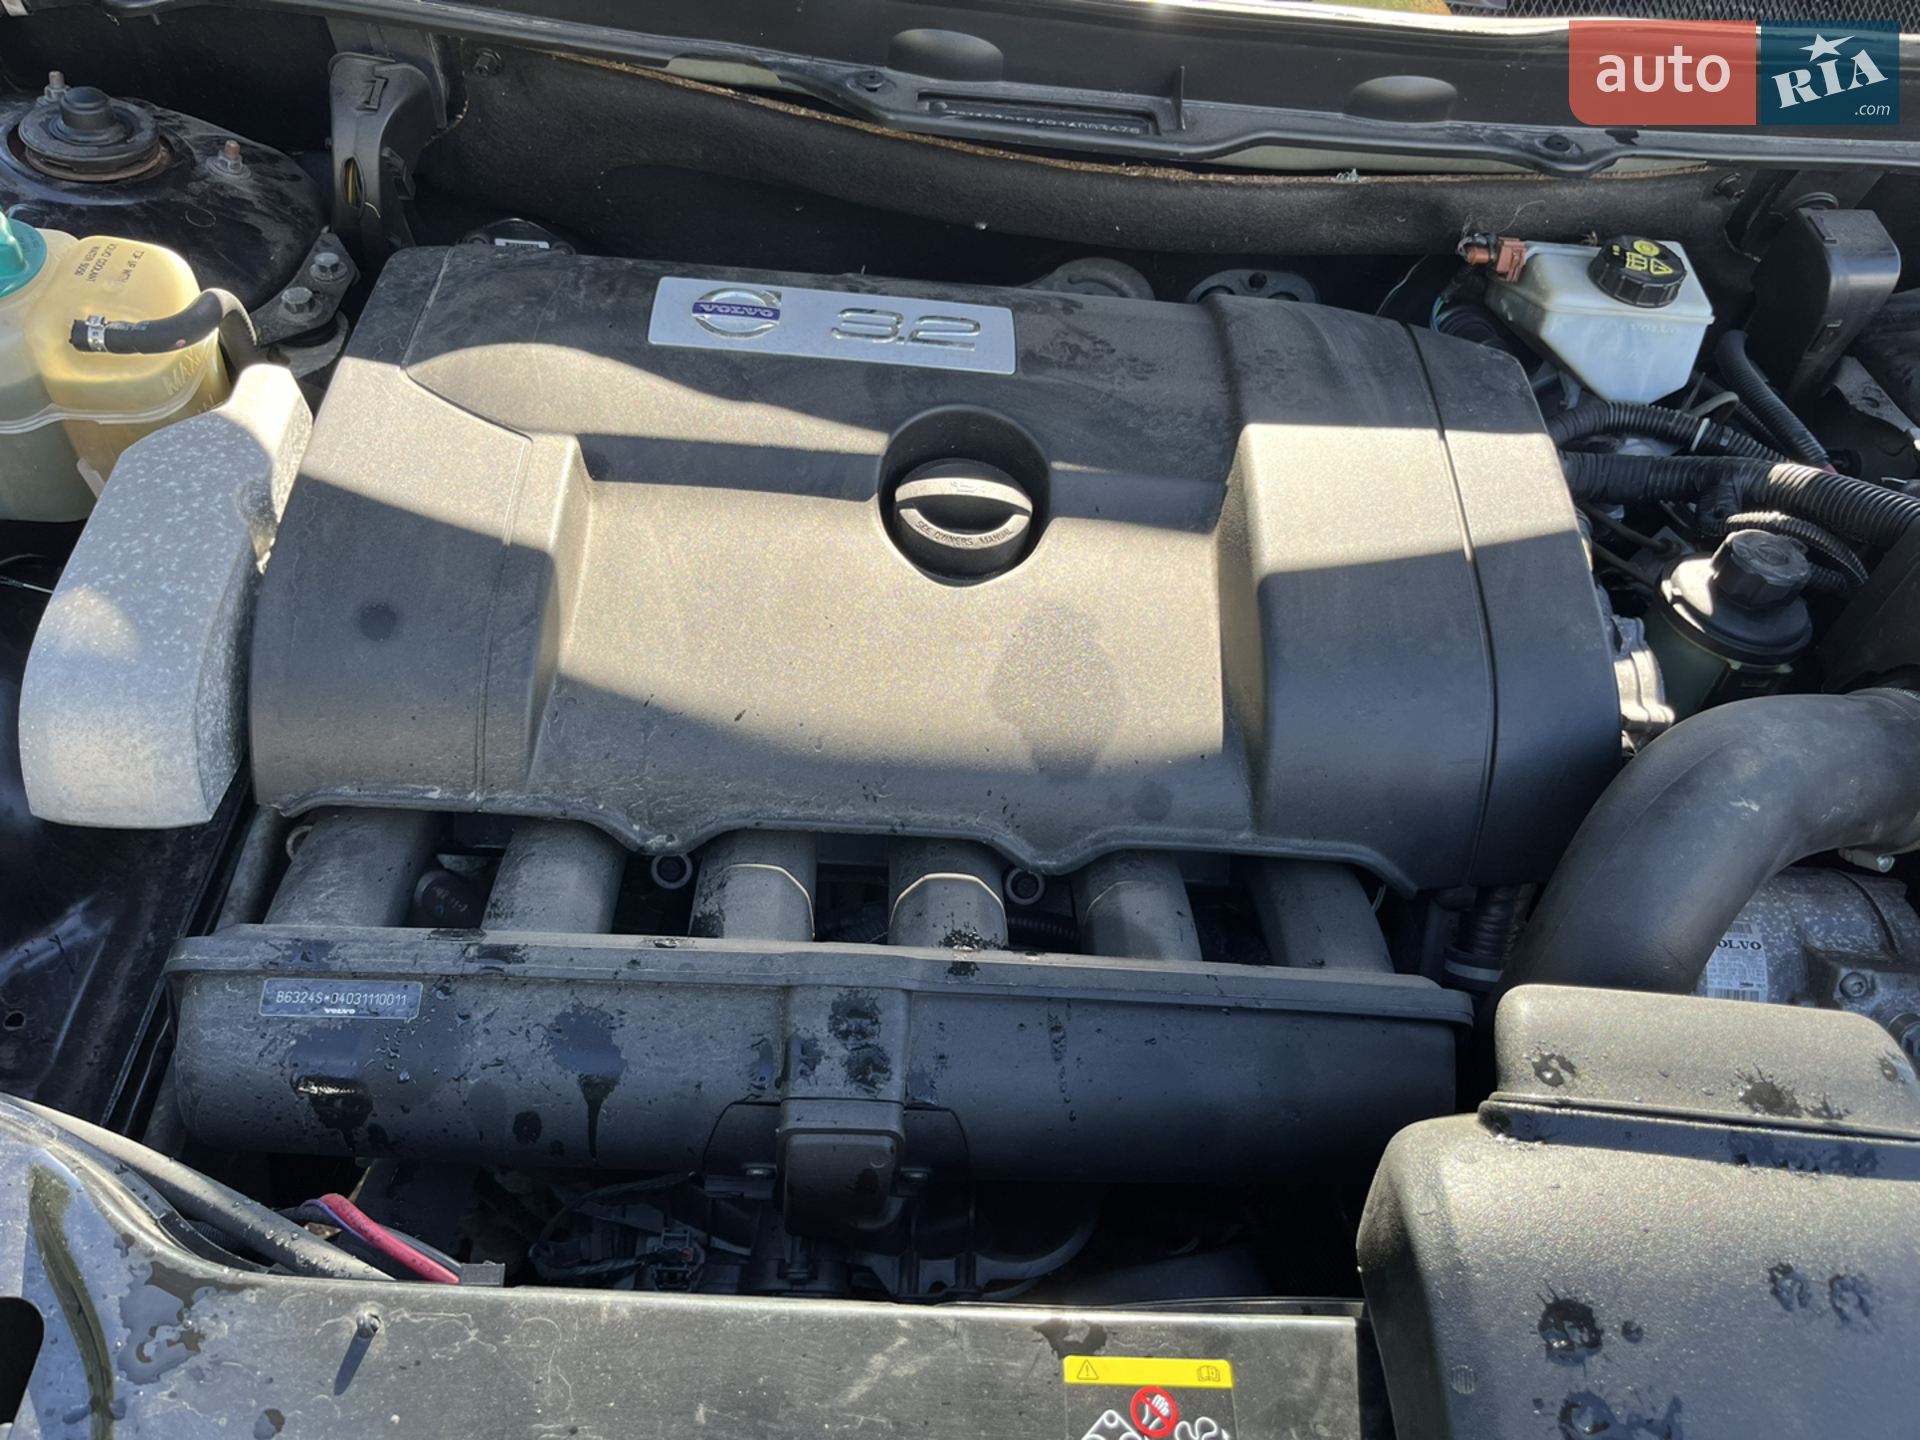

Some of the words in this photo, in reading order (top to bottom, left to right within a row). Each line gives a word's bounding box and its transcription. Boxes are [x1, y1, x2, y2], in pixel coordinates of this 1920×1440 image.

[698, 303, 775, 319] VOLVO
[831, 307, 981, 352] 3.2
[162, 348, 201, 396] MAX
[914, 520, 932, 536] SEE
[979, 528, 1014, 544] MANUAL
[1717, 940, 1762, 950] OLVO
